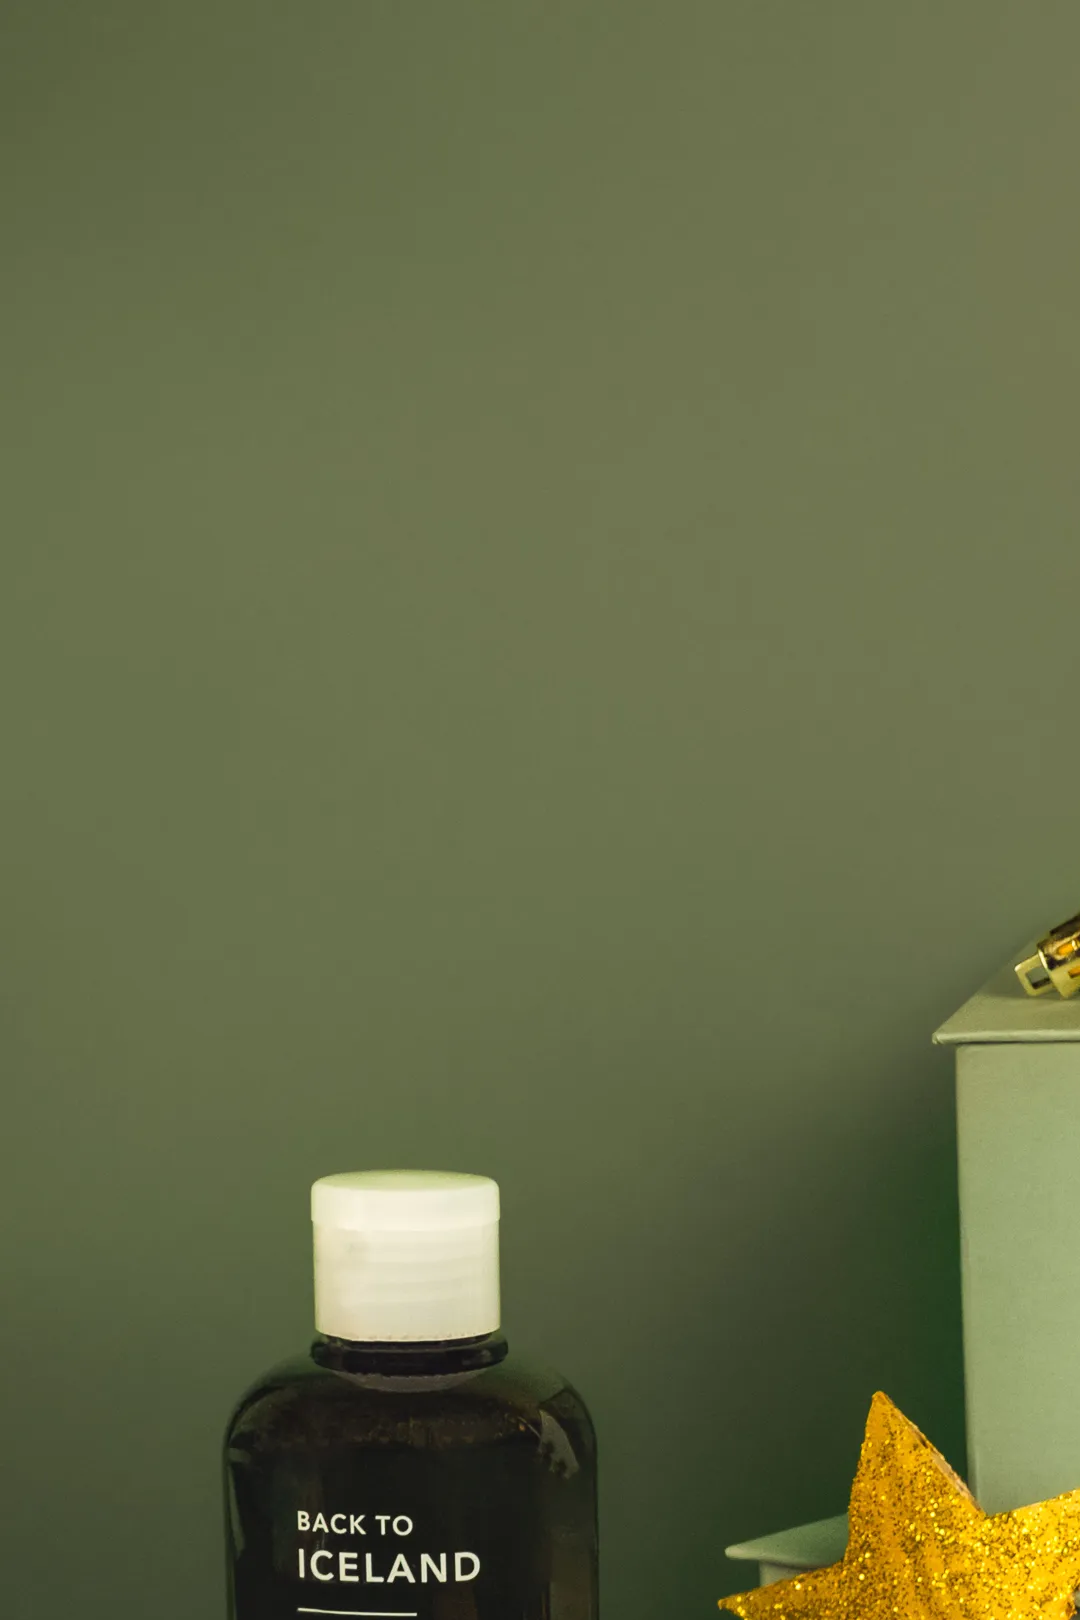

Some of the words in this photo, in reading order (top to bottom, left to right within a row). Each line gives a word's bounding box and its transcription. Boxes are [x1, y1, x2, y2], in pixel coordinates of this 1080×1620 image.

[297, 1510, 366, 1535] BACK
[375, 1515, 413, 1536] TO
[299, 1548, 481, 1583] ICELAND
